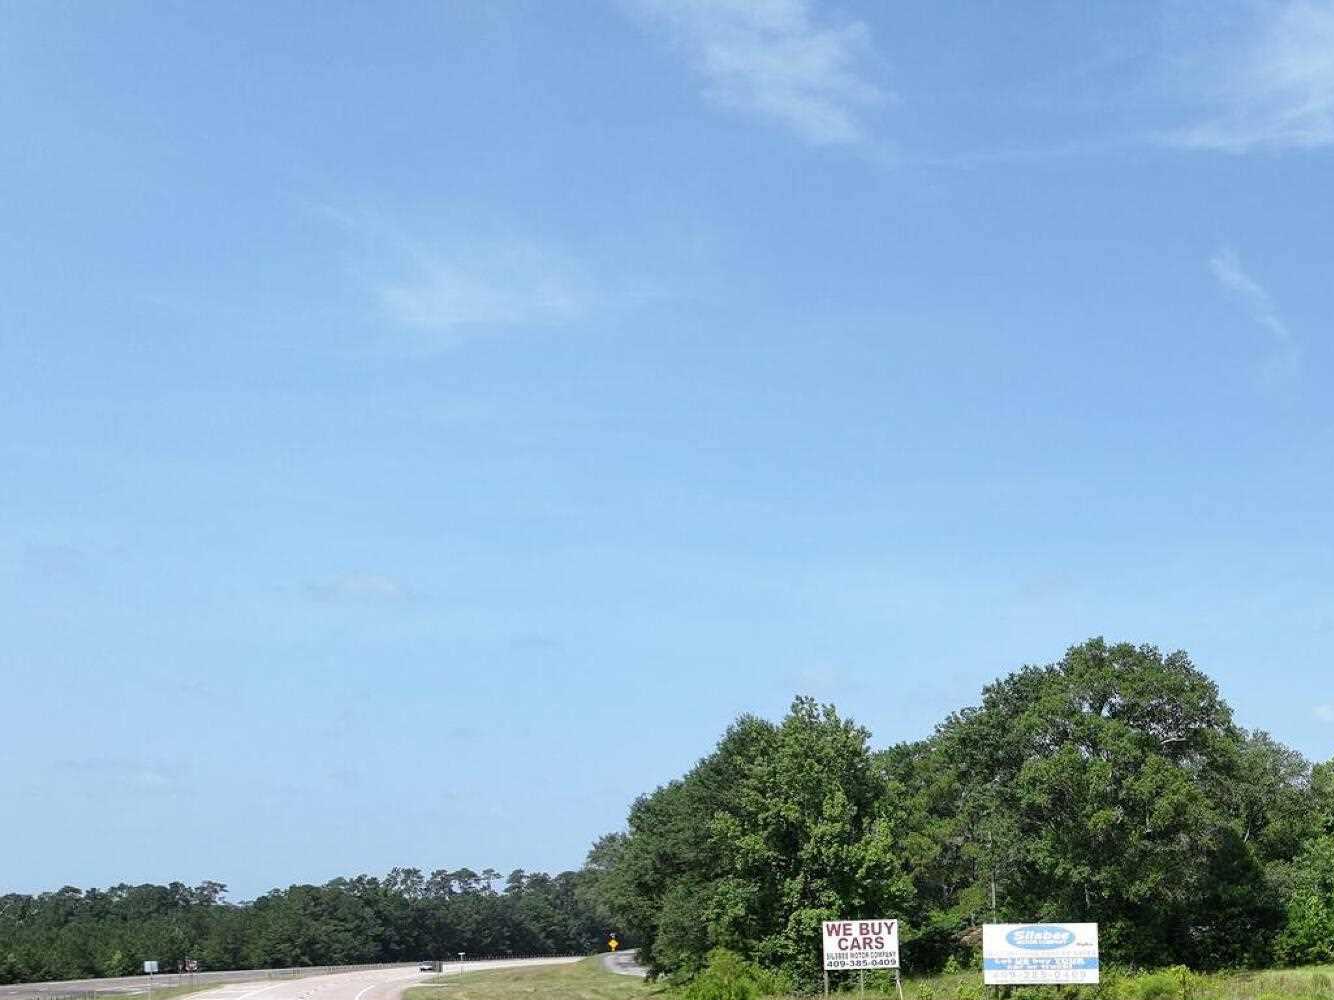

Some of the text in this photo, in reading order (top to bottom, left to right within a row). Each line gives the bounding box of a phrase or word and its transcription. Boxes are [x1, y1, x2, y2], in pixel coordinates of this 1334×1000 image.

[826, 922, 895, 936] WE BUY
[838, 936, 885, 950] CARS
